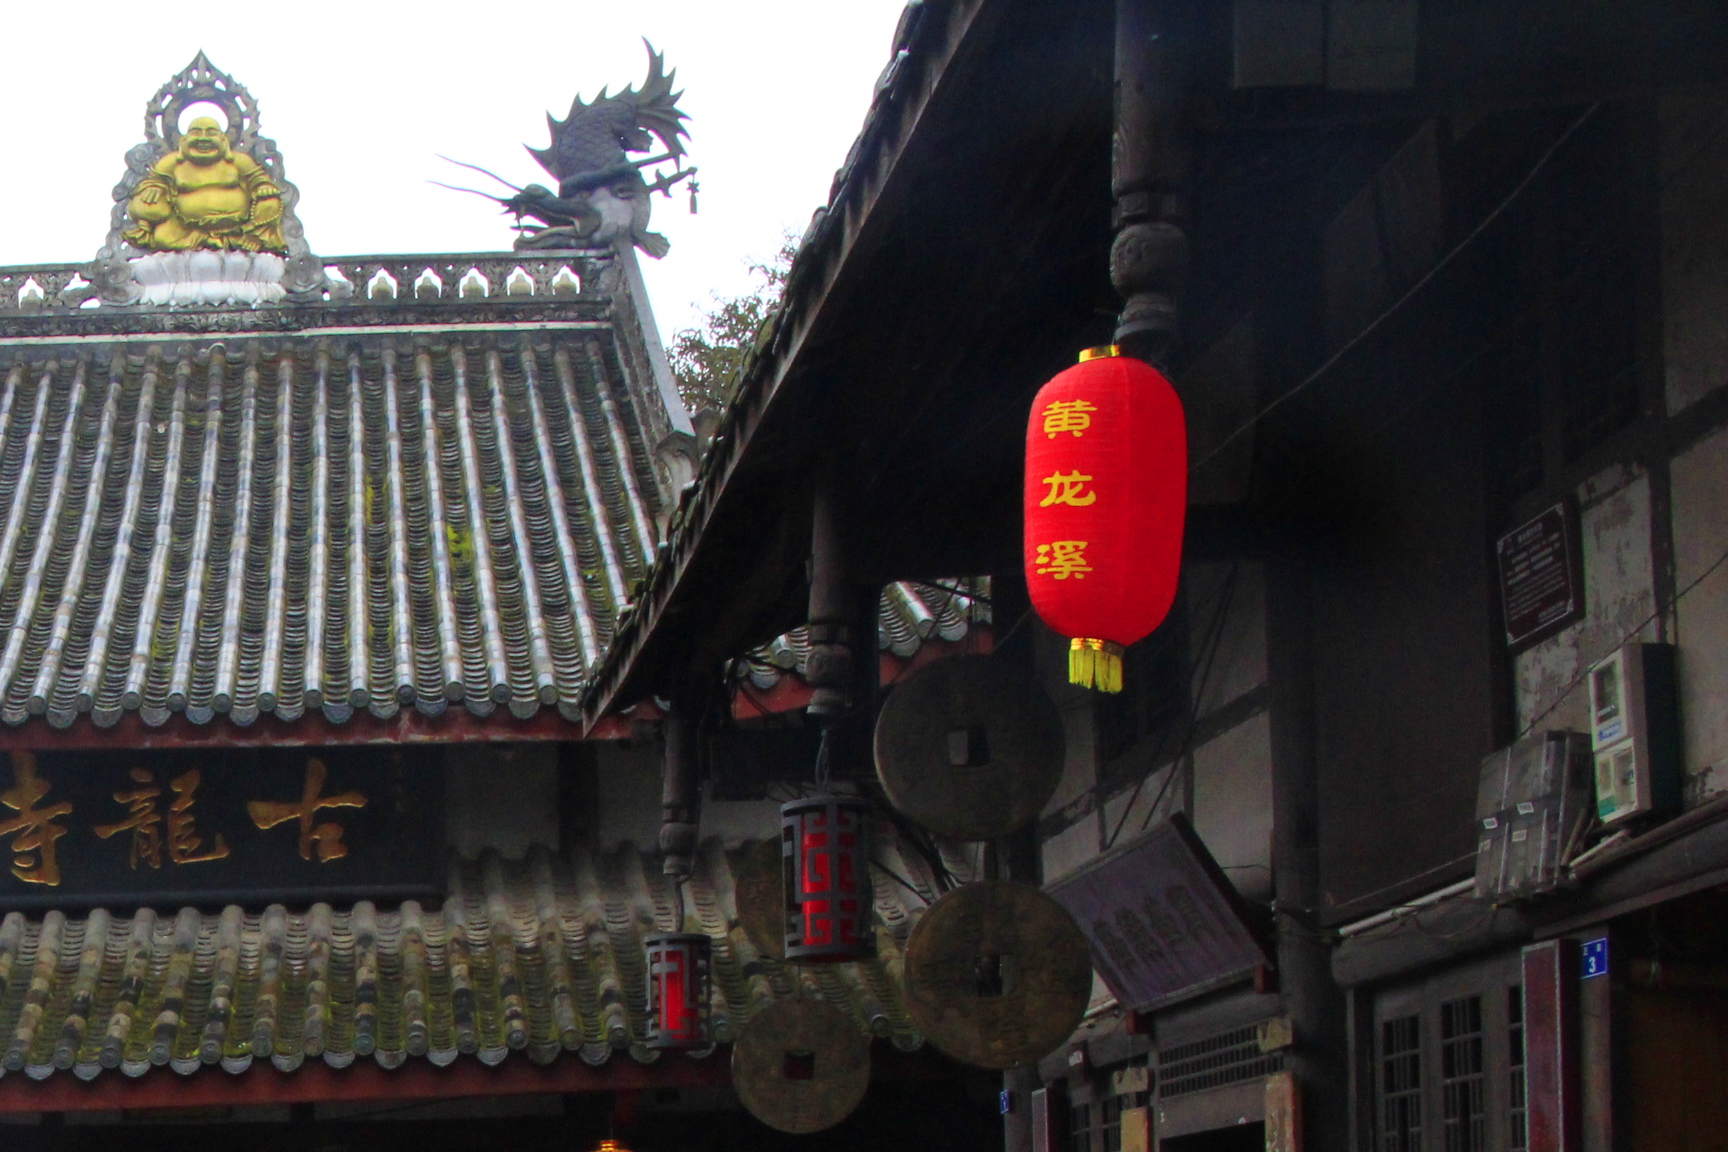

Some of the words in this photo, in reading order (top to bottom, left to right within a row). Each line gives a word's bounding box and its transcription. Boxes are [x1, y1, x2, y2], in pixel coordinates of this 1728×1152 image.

[1035, 399, 1098, 580] 黄龙溪
[1588, 956, 1596, 973] 3
